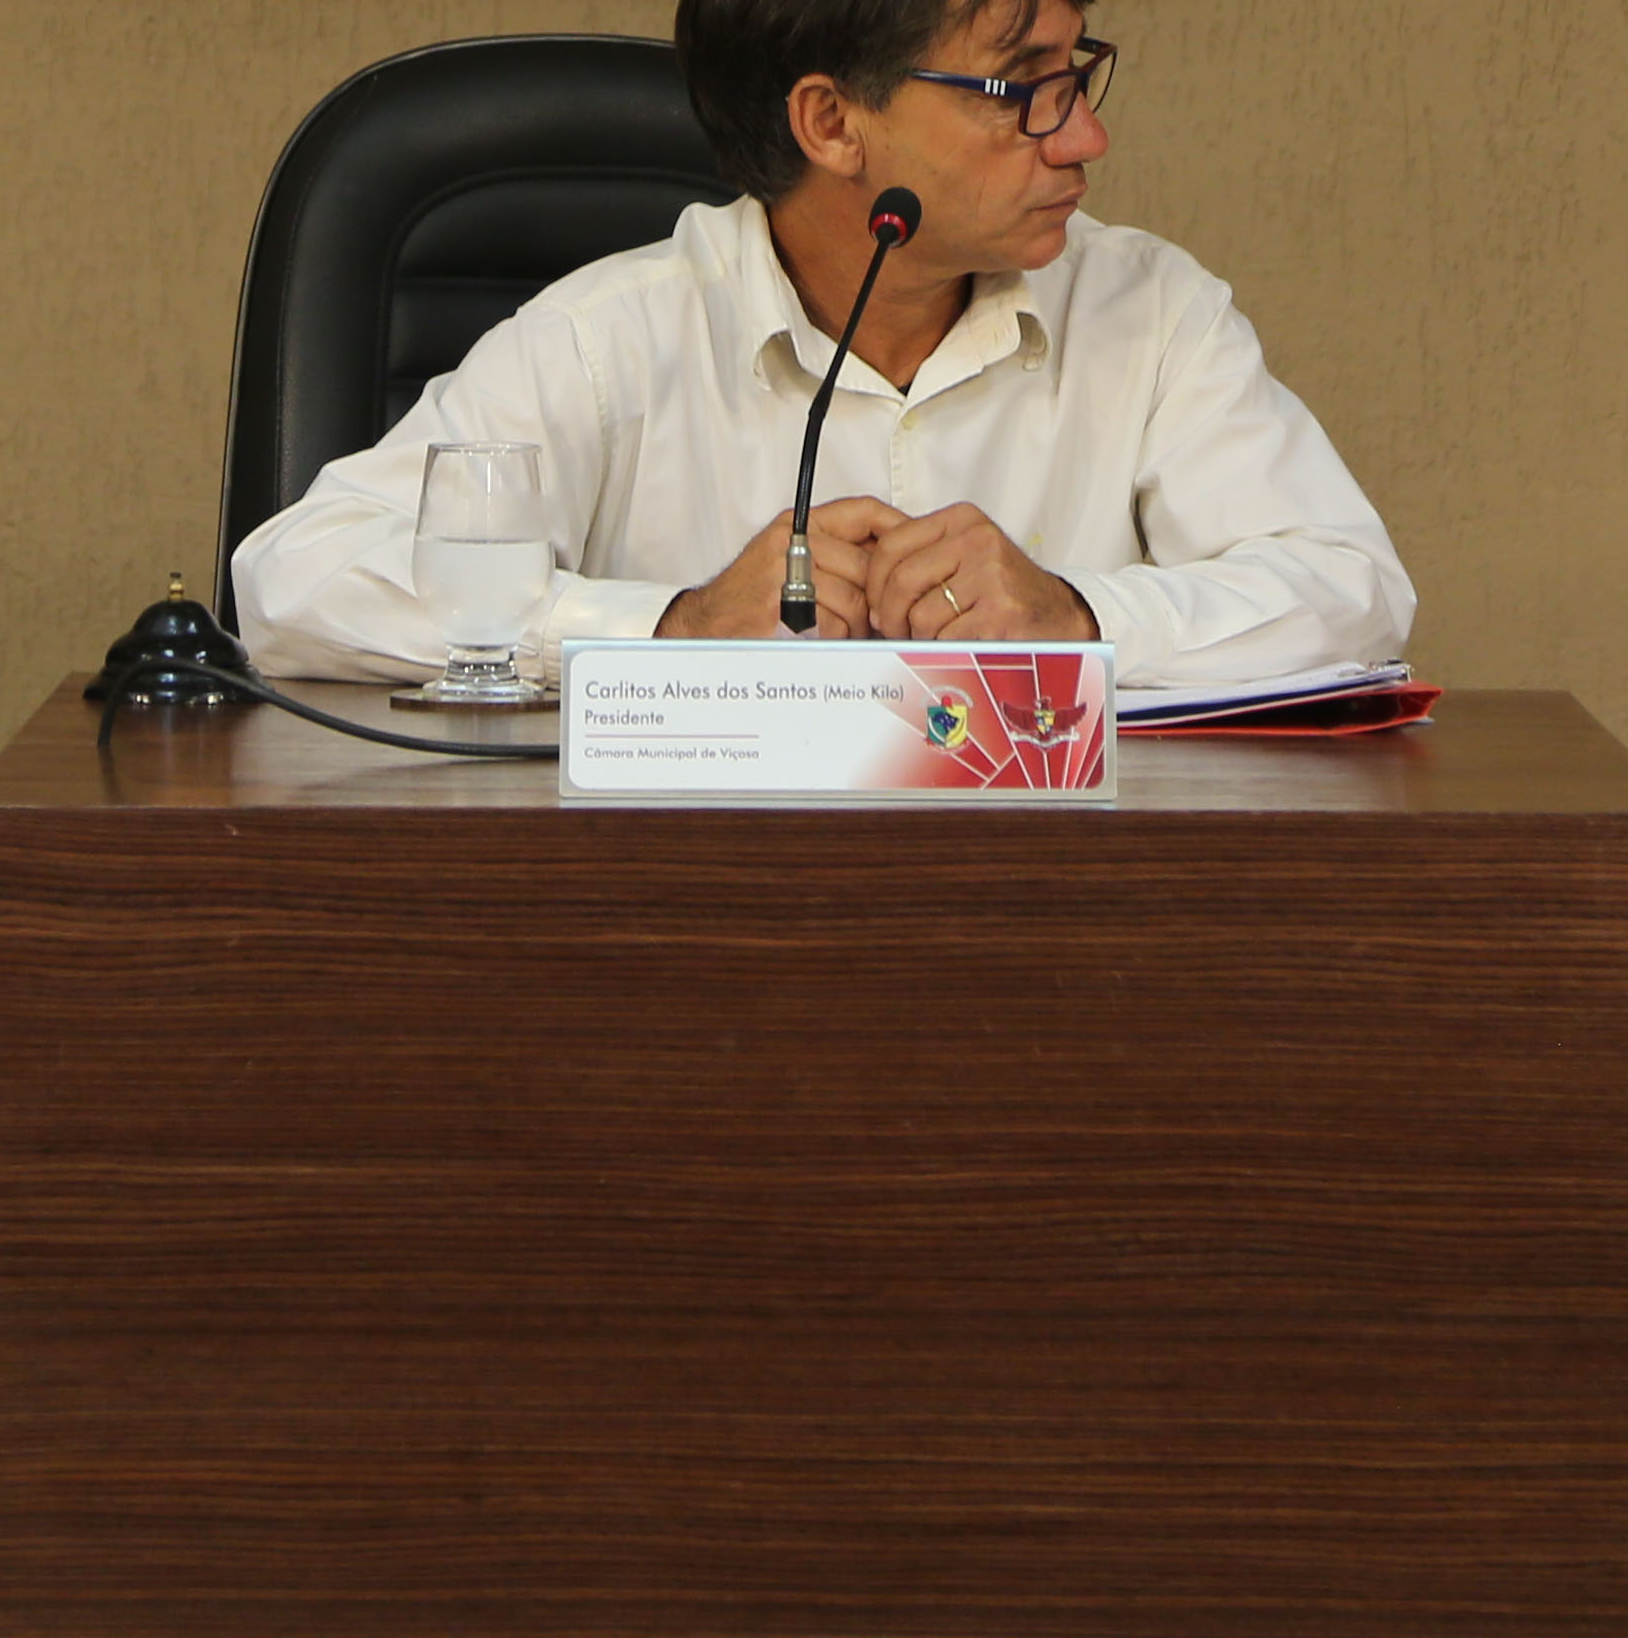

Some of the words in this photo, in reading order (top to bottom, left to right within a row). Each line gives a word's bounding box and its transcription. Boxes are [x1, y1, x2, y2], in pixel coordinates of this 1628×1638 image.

[585, 681, 656, 700] Carlitos
[662, 681, 710, 700] Alves
[717, 681, 749, 700] dos
[755, 681, 817, 700] Santos
[823, 684, 866, 703] (Meio
[871, 684, 905, 703] Kilo)
[584, 709, 665, 726] Presidente
[584, 747, 633, 760] Câmara
[638, 747, 697, 762] Municipal
[701, 747, 716, 759] de
[721, 748, 760, 761] Viçosa
